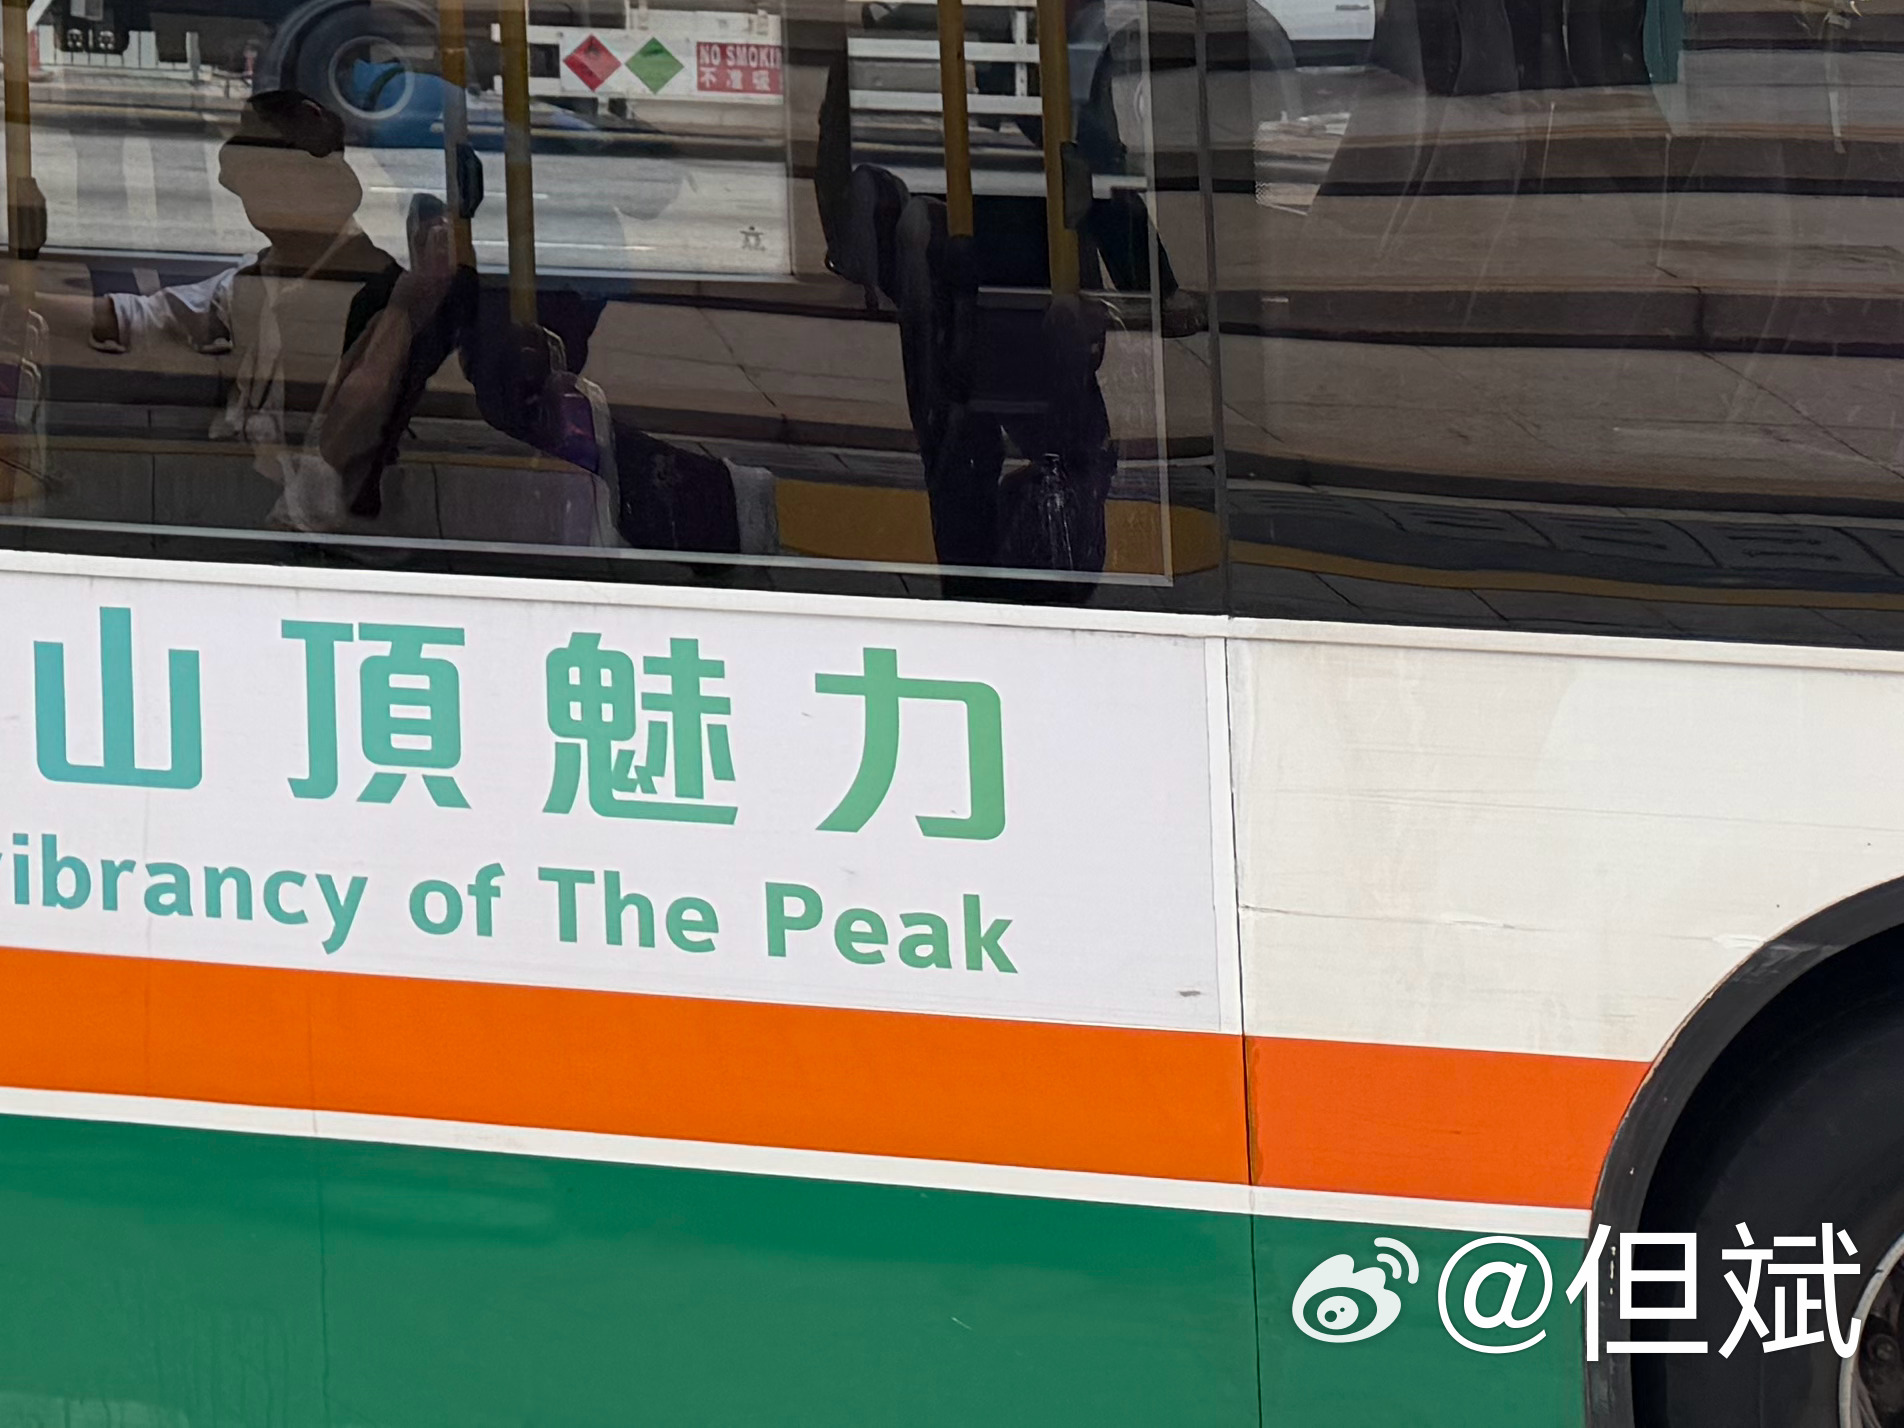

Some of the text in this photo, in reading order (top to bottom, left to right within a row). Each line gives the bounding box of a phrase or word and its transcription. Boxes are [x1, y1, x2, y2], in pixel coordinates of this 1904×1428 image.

[699, 44, 721, 66] NO
[407, 857, 503, 938] of
[538, 867, 721, 955] The
[764, 881, 1019, 976] Peak
